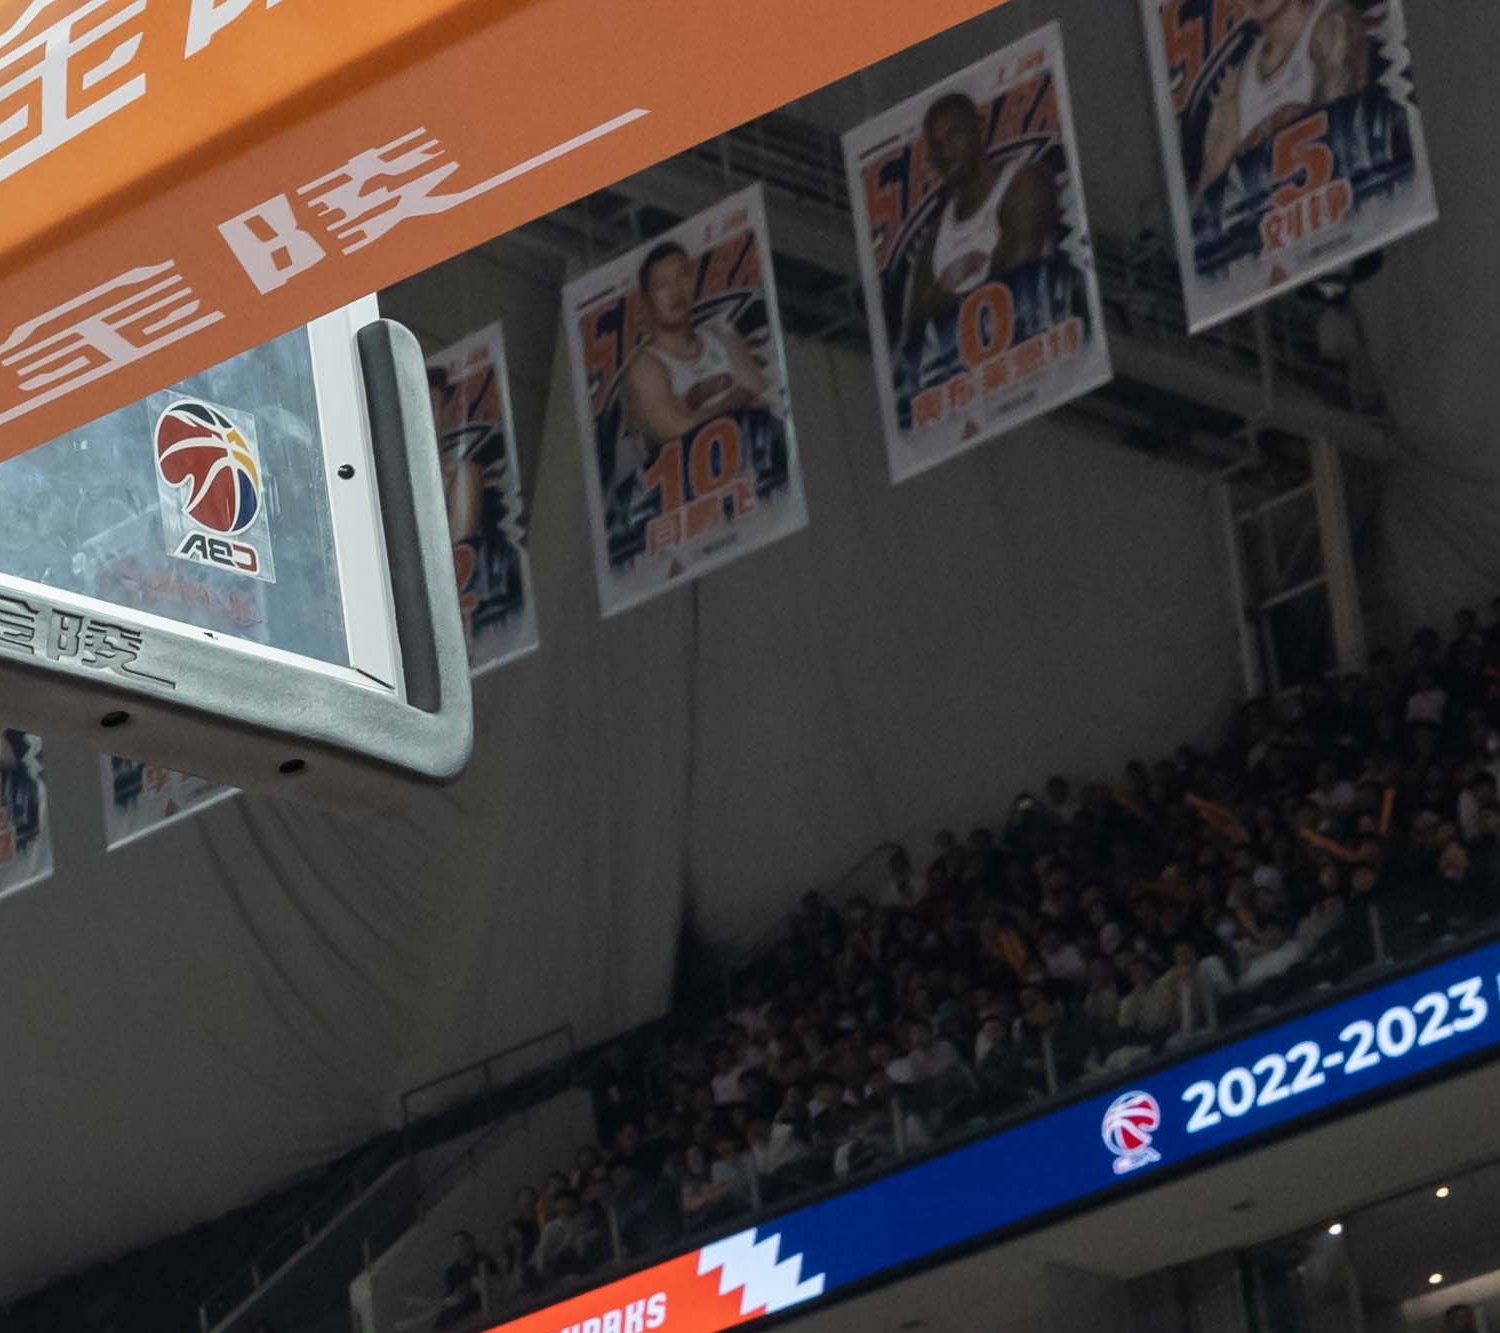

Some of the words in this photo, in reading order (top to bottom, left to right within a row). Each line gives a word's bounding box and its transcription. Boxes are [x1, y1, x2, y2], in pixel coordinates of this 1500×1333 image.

[1271, 110, 1334, 208] 5
[644, 418, 741, 517] 10
[1181, 976, 1487, 1134] 2022-2023
